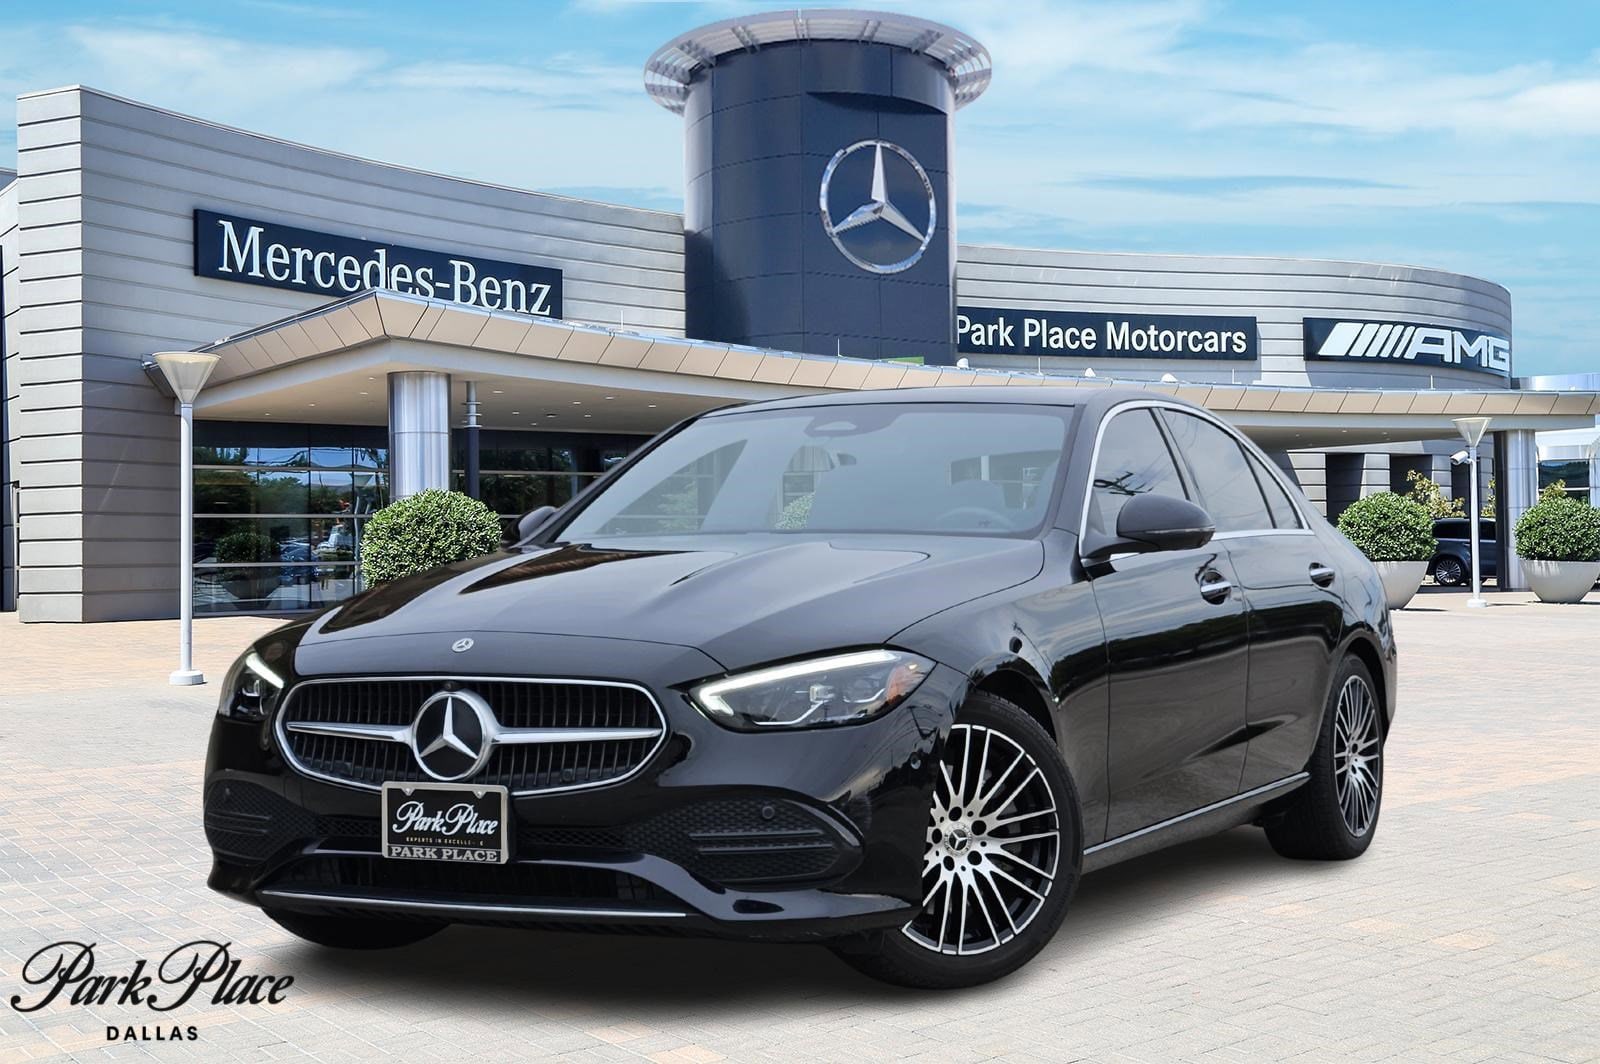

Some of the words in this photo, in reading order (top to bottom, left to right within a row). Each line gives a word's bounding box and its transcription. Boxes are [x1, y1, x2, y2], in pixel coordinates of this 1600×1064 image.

[218, 219, 552, 316] Mercedes-Benz
[957, 315, 1014, 347] Park
[1024, 318, 1097, 350] Place
[1106, 321, 1247, 353] Motorcars
[1404, 326, 1510, 372] AMG
[392, 800, 444, 833] Park
[441, 803, 498, 835] Place
[391, 846, 438, 859] PARK
[441, 848, 497, 862] PLACE
